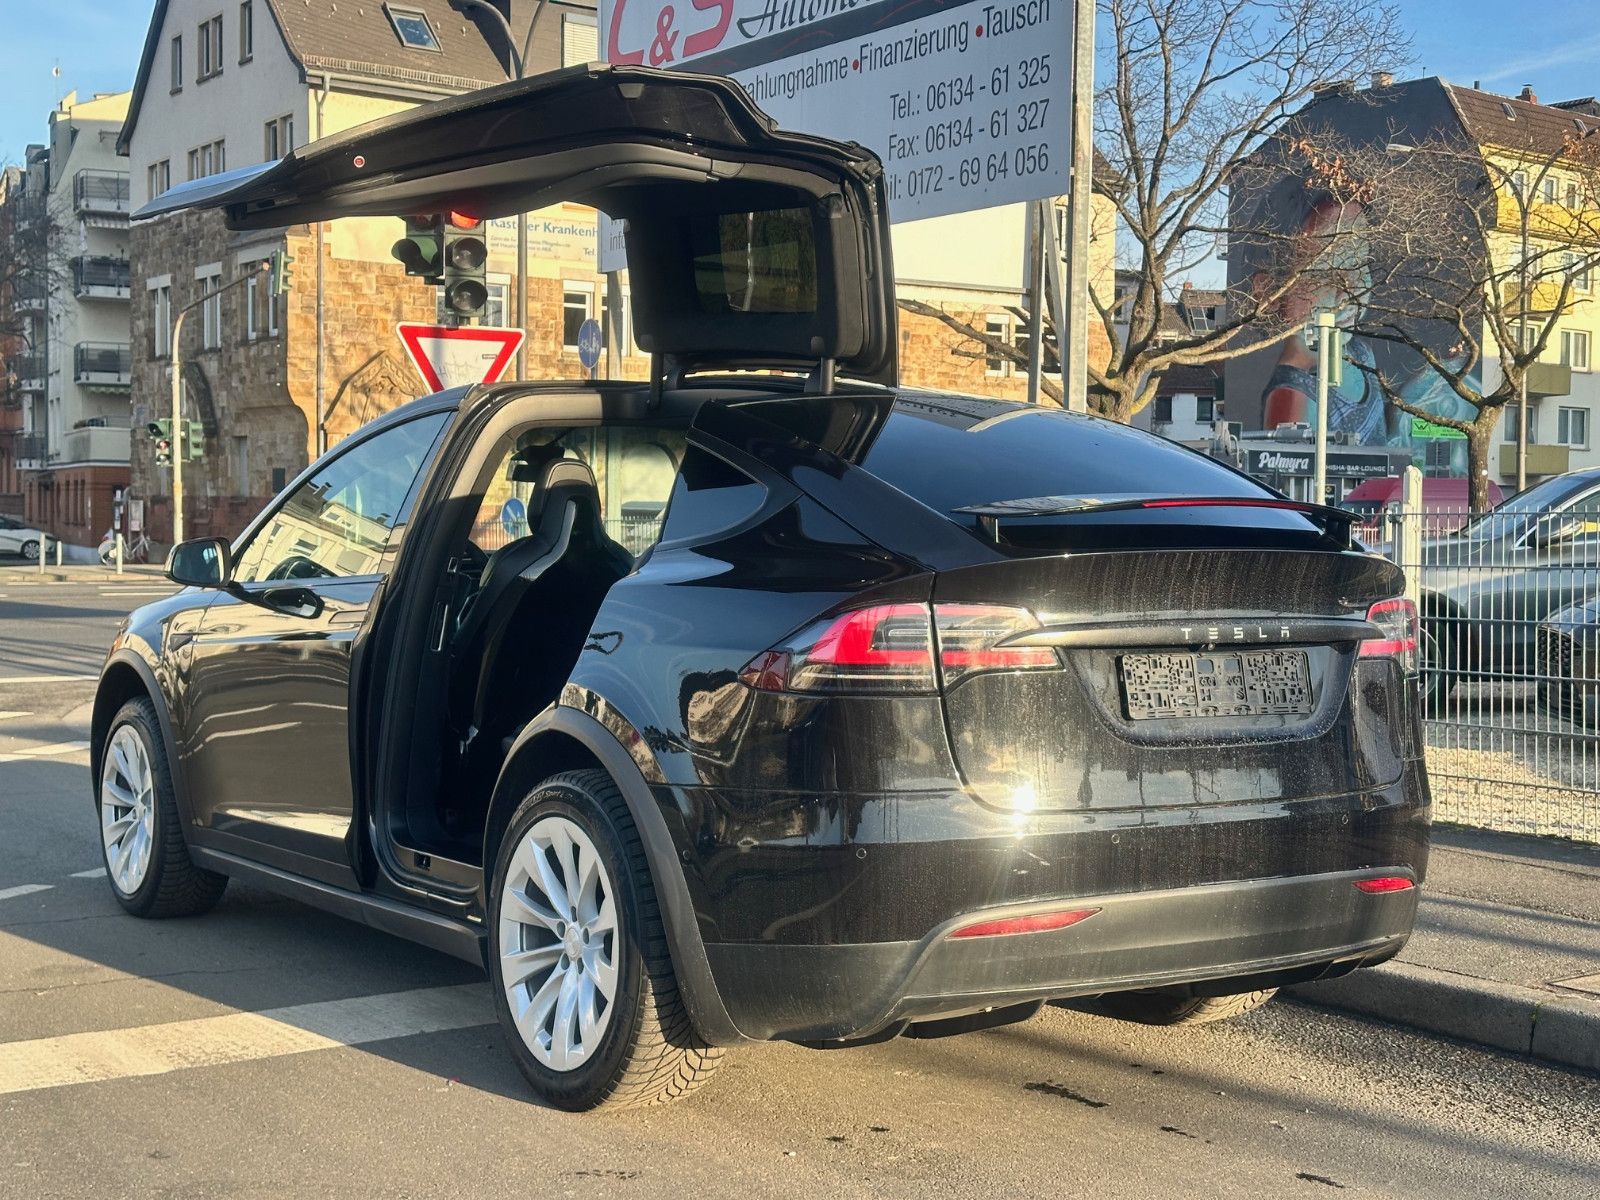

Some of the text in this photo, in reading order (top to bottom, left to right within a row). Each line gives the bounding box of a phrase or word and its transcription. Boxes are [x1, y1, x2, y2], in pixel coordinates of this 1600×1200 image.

[743, 0, 1050, 101] ahlungnahme Finanzierung Tausch
[890, 91, 920, 120] Tel.:
[926, 74, 974, 112] 06134
[991, 64, 1009, 96] 61
[1018, 54, 1050, 89] 325
[888, 134, 919, 161] Fax:
[926, 116, 973, 153] 06134
[990, 108, 1008, 139] 61
[1017, 98, 1050, 133] 327
[908, 164, 943, 197] 0172
[960, 157, 981, 187] 69
[987, 151, 1008, 182] 64
[1015, 143, 1049, 176] 056
[1258, 452, 1309, 472] Palmyra
[1181, 626, 1290, 640] TESLA
